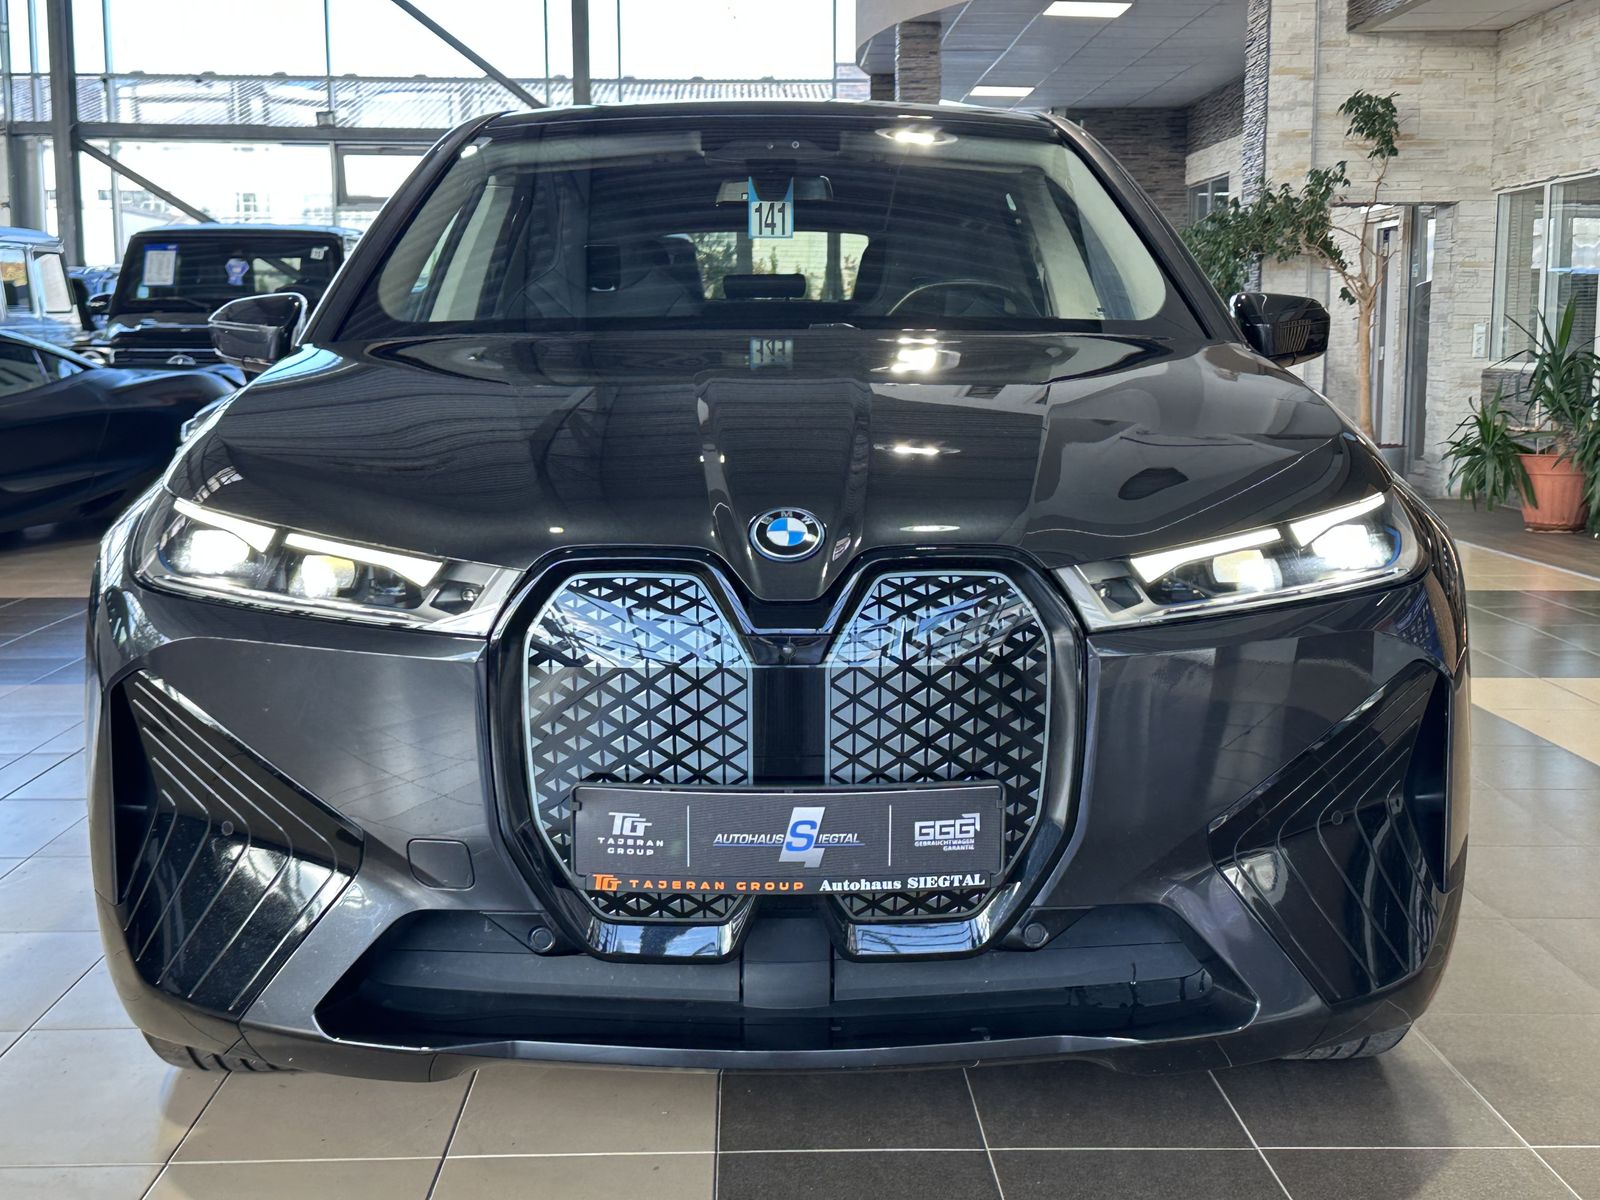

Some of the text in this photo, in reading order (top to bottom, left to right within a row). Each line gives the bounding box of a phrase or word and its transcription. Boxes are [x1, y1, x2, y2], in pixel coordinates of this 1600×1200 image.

[754, 202, 786, 235] 141
[760, 511, 814, 525] BMW
[608, 812, 652, 836] TG
[914, 818, 975, 840] GGG
[597, 837, 664, 847] TAJERAN
[713, 820, 860, 852] AUTOHAUS SIEGTAL
[914, 838, 975, 847] GEBRAUCHTWAGEN
[607, 847, 654, 856] GROUP
[592, 873, 804, 891] TG TAJERAN GROUP
[819, 873, 986, 892] Autohaus SIEGTAL
